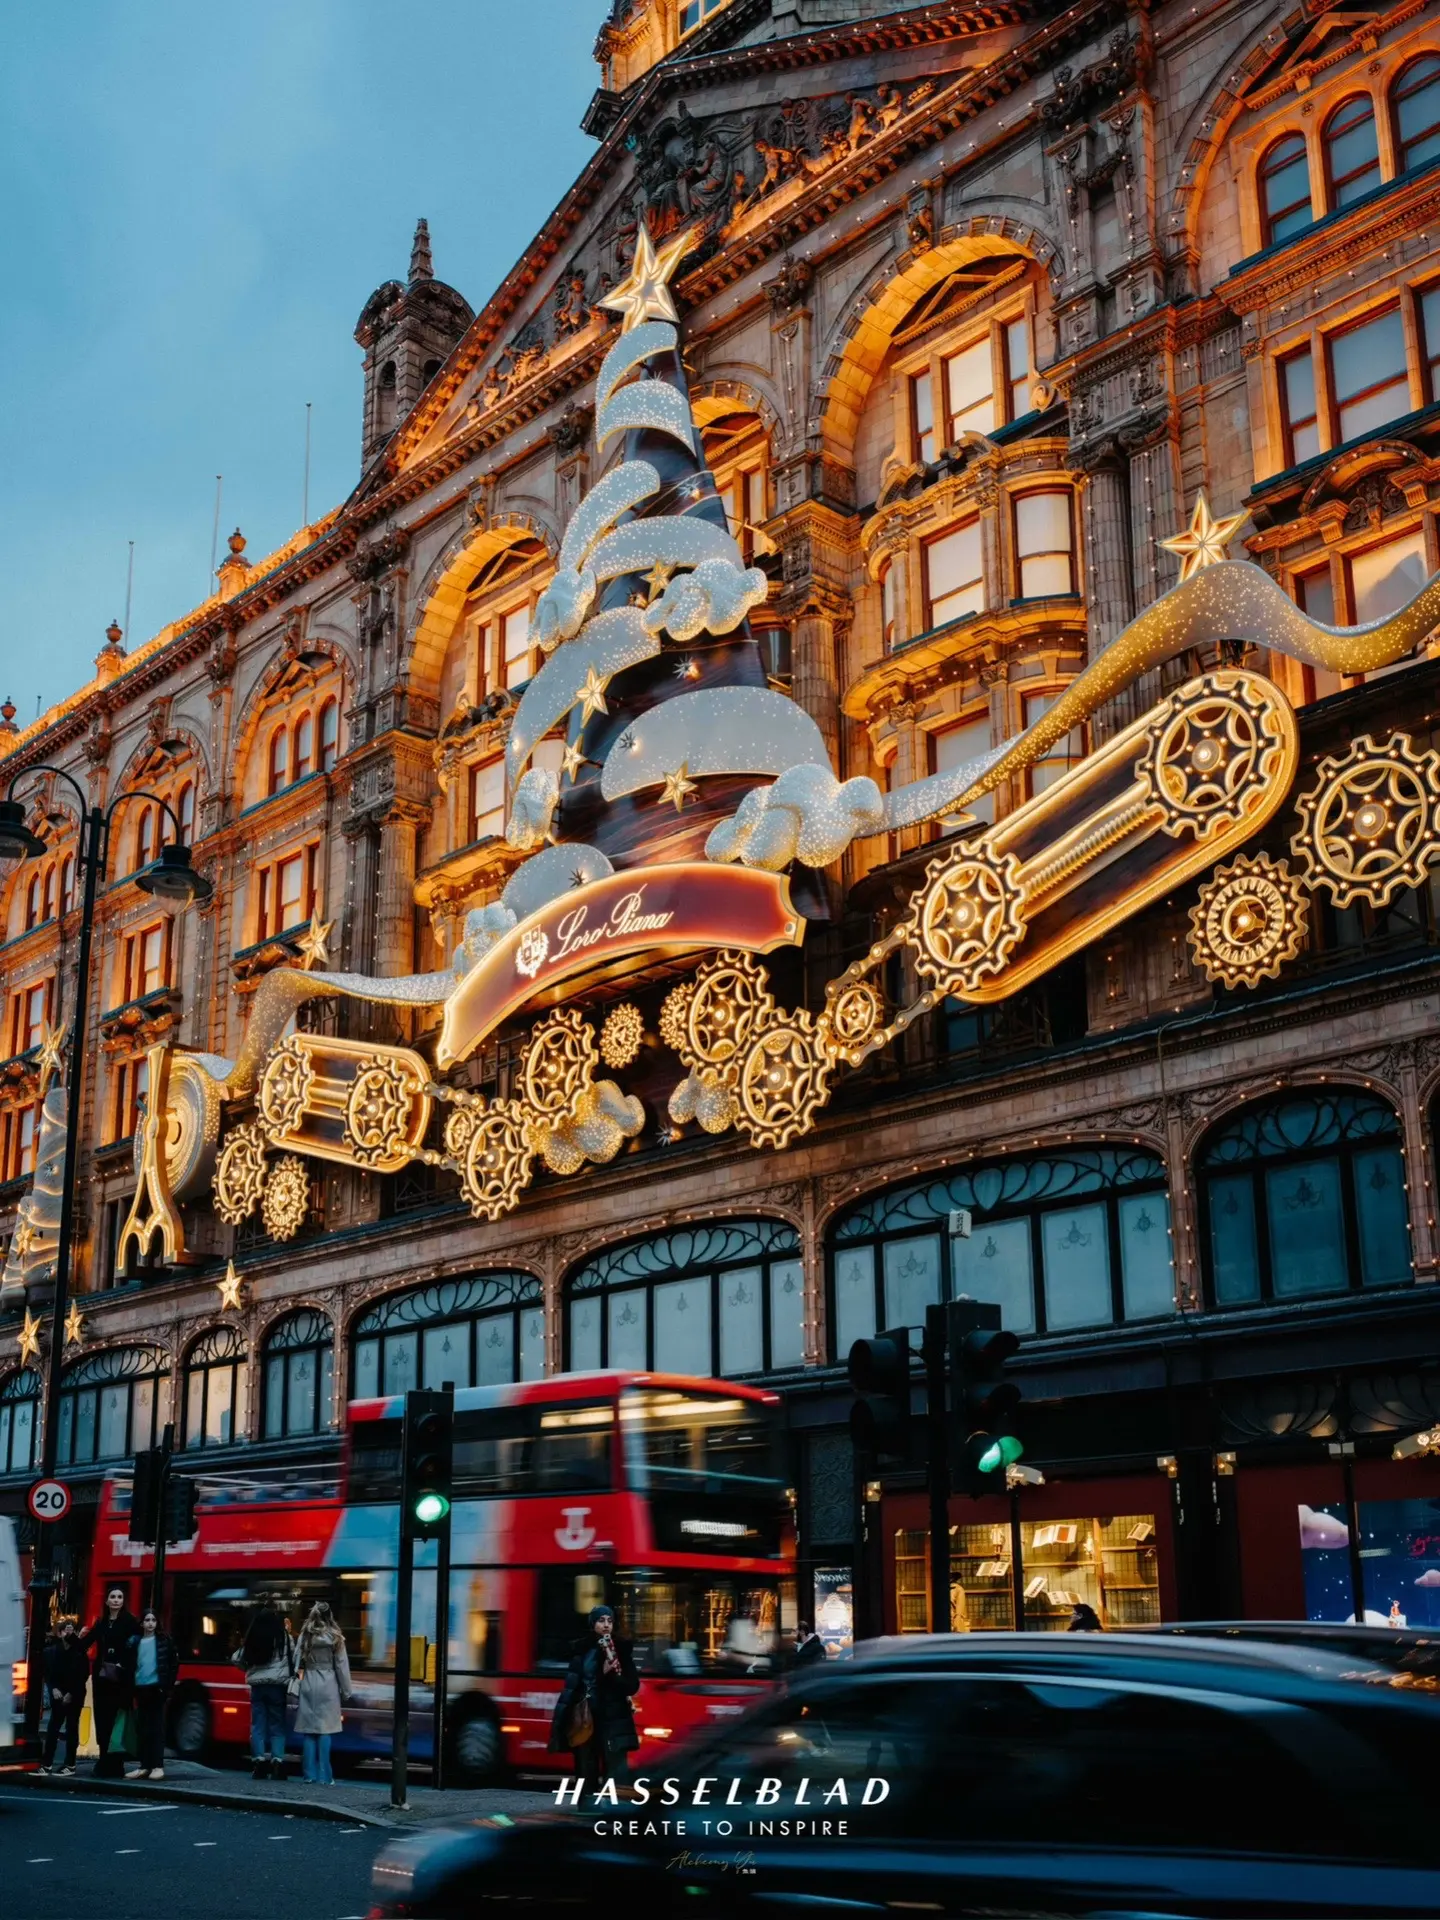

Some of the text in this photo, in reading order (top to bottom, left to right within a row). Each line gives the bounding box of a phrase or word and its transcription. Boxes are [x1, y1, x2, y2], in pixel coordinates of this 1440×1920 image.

[549, 883, 674, 963] Loro Piana
[35, 1491, 65, 1510] 20
